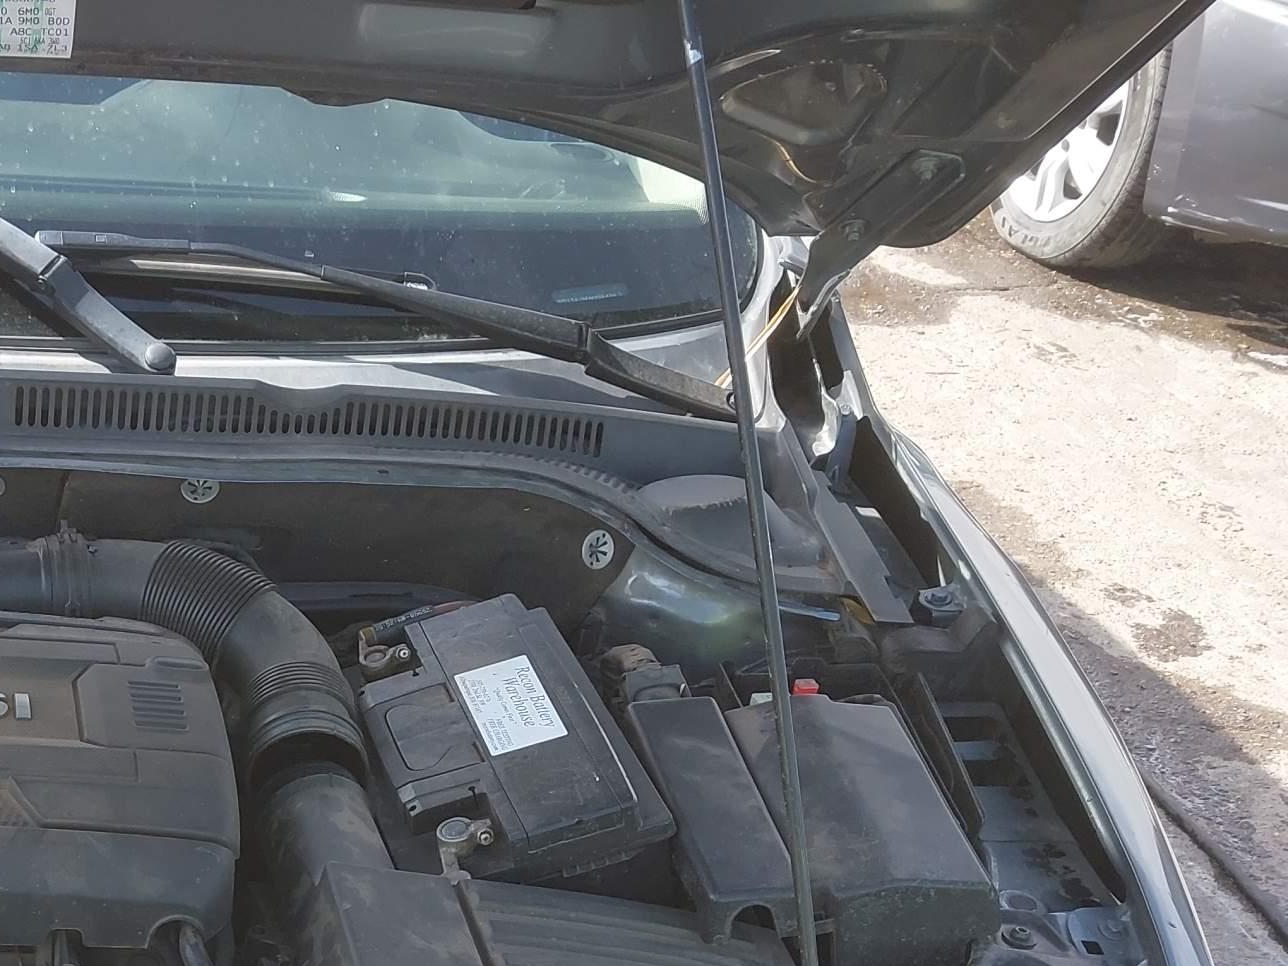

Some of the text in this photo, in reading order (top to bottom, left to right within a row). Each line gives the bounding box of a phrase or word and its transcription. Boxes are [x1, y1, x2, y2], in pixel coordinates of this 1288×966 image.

[502, 678, 536, 727] Warehouse
[515, 666, 555, 727] Recon Battery
